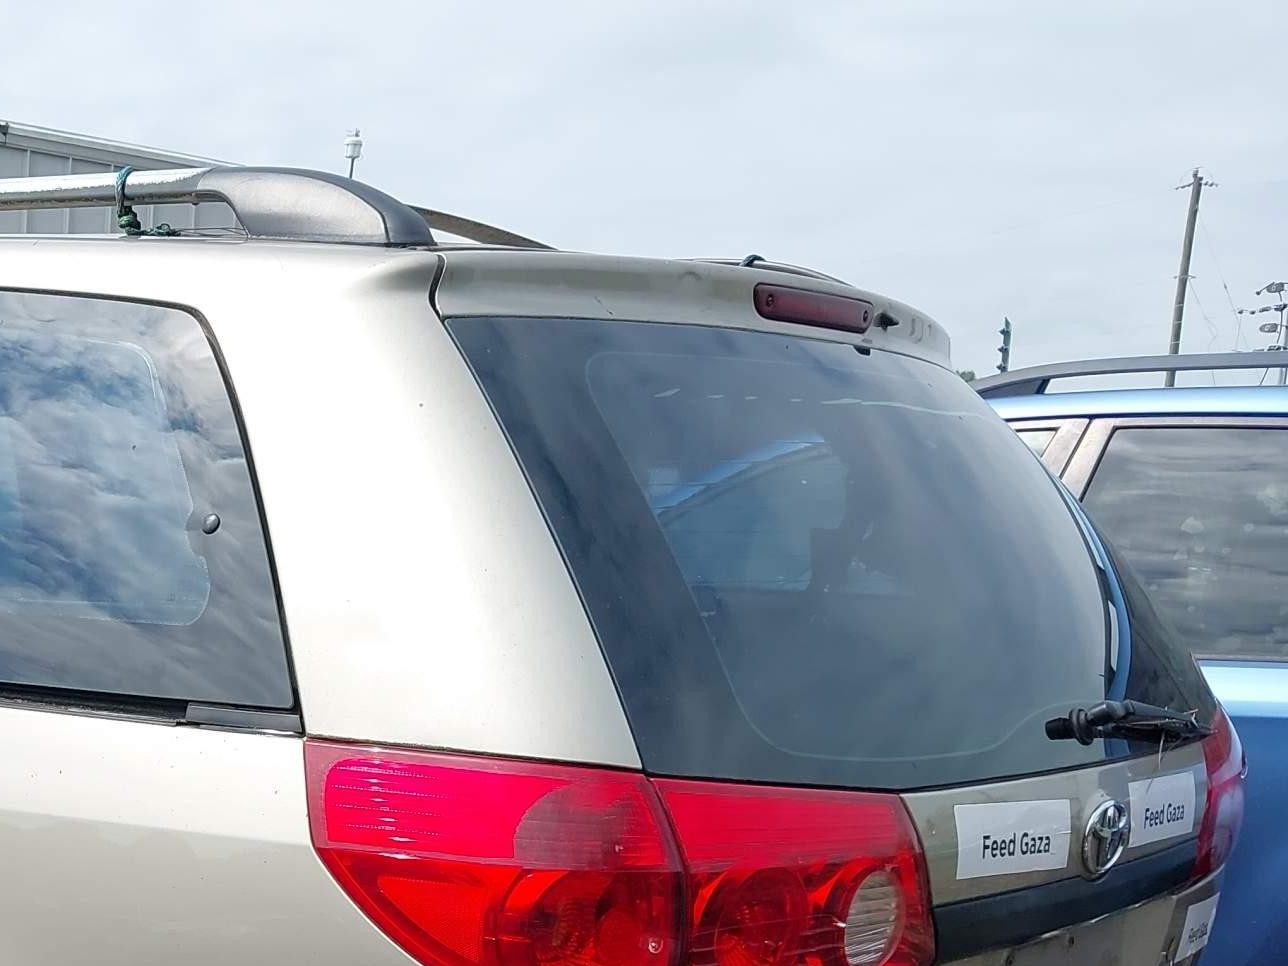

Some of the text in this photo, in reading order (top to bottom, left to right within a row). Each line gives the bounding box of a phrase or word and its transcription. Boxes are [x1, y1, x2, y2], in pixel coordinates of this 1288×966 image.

[1143, 802, 1185, 830] Feed Gaza
[982, 831, 1051, 860] Feed Gaza
